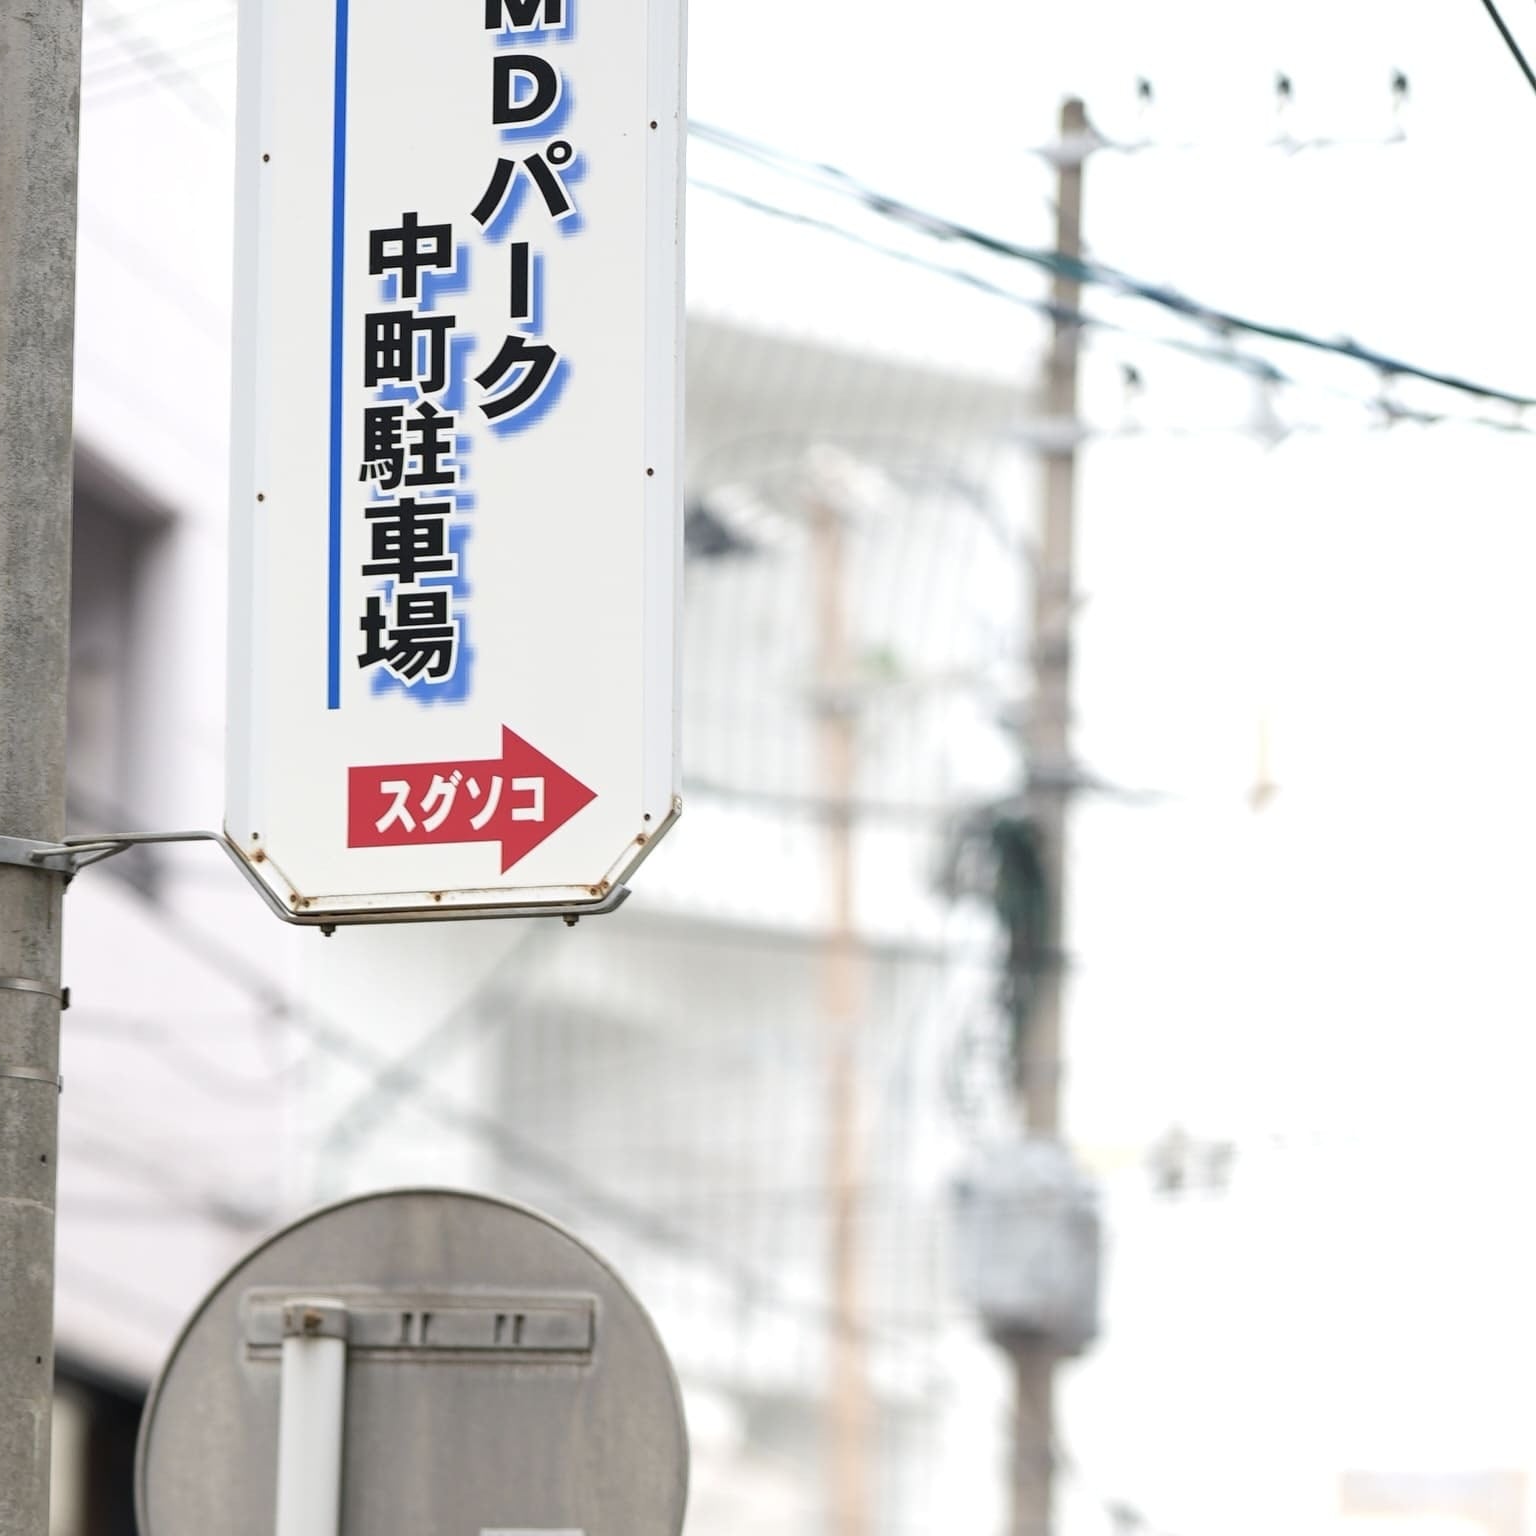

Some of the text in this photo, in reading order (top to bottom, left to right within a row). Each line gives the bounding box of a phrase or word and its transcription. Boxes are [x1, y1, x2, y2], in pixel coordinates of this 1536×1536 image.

[357, 210, 457, 682] 中町駐車場
[375, 769, 545, 833] スグソコ
